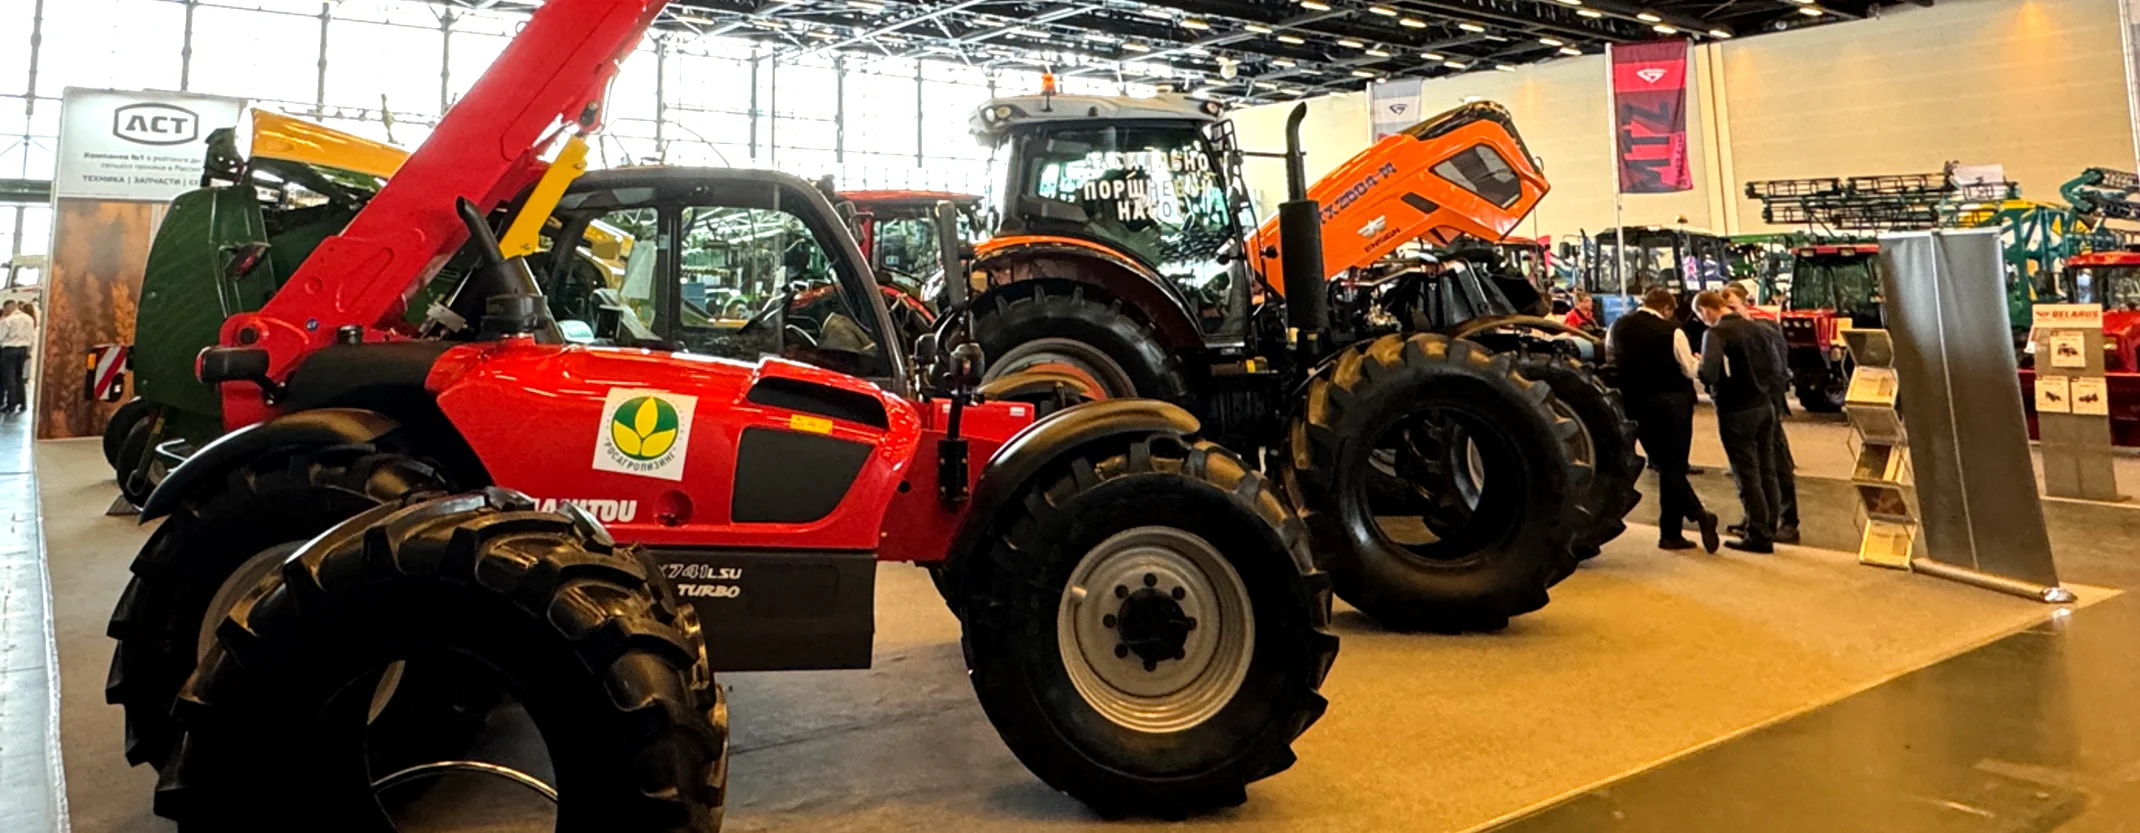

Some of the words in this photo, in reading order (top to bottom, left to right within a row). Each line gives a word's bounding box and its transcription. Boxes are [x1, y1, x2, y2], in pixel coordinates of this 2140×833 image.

[82, 175, 125, 183] ТЕХНИКА
[134, 177, 181, 186] ЗАПЧАСТИ
[2051, 310, 2099, 318] BELARUS
[678, 584, 740, 598] TURBO
